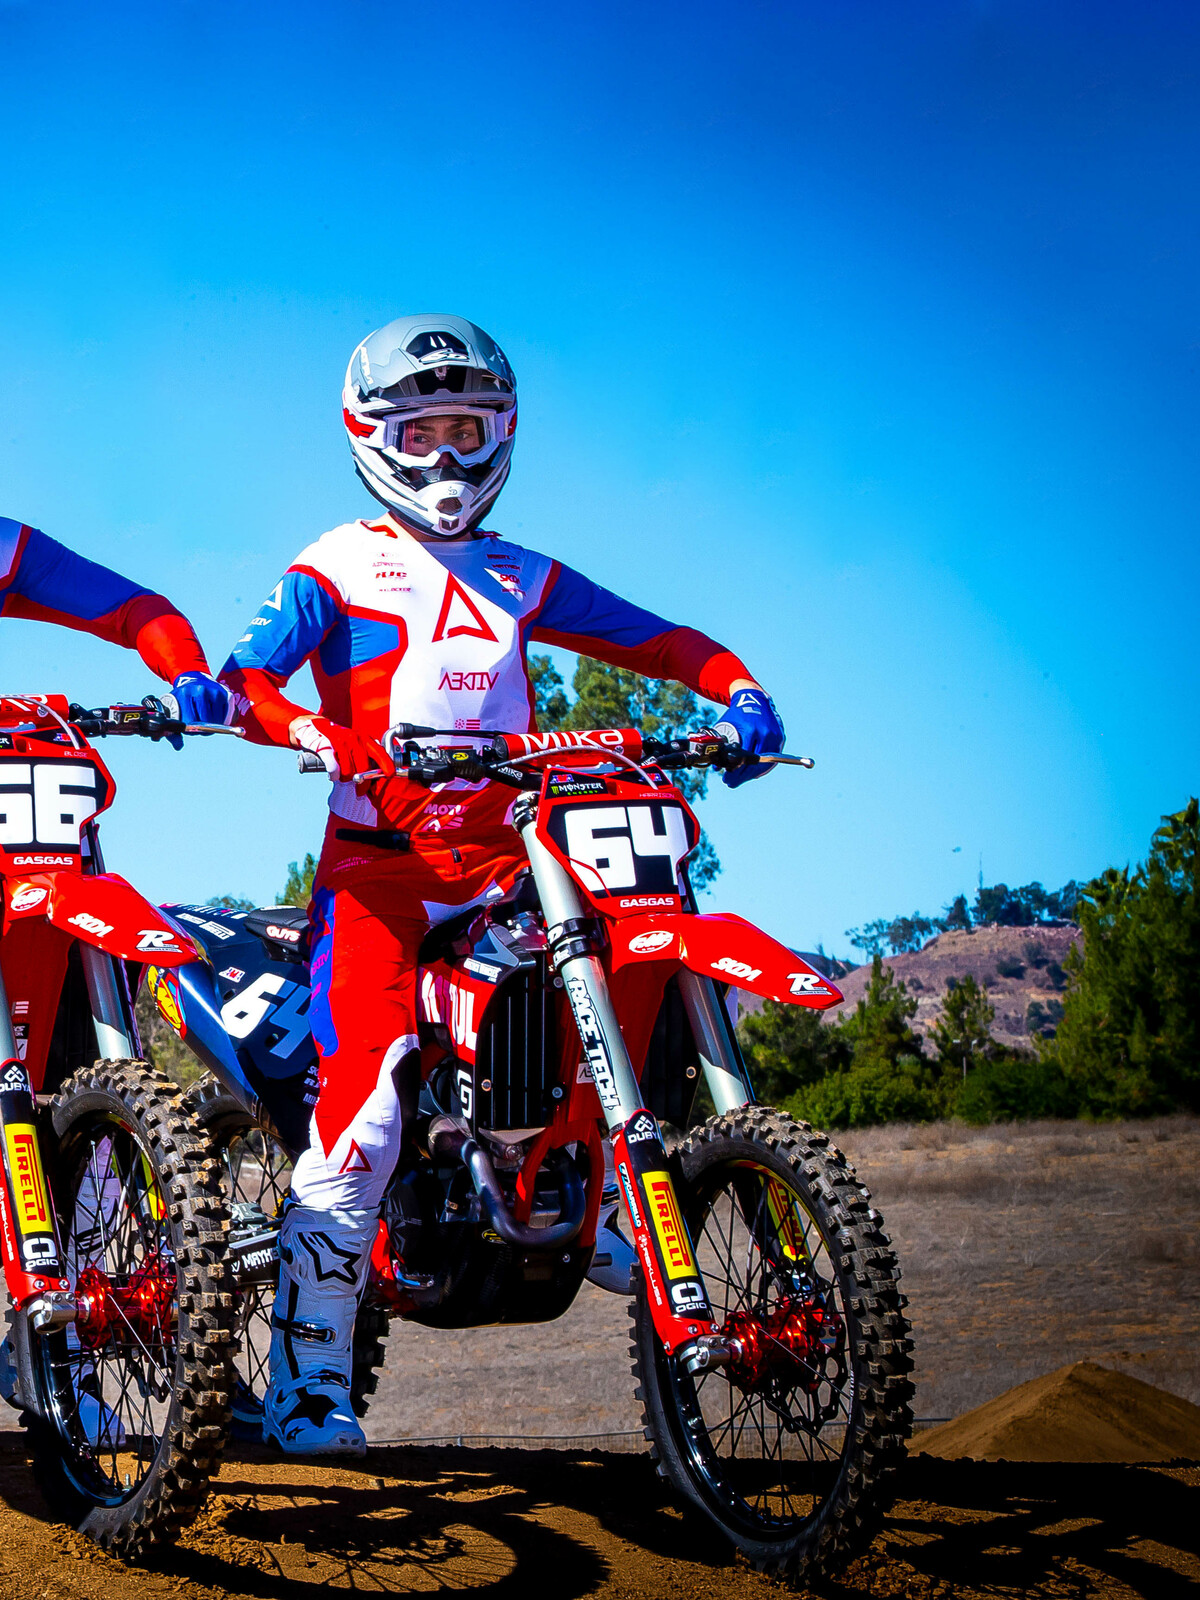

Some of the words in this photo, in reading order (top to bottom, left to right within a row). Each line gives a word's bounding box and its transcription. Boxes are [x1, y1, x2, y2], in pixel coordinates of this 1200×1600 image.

[558, 782, 604, 791] MONSTER
[564, 806, 689, 893] 64
[13, 856, 73, 865] GASGAS
[620, 897, 674, 908] GASGAS
[265, 925, 301, 942] GUTS
[567, 979, 601, 1040] RACE
[589, 1041, 621, 1108] TECH
[13, 1134, 47, 1222] PIRELLI
[651, 1181, 691, 1267] PIRELLI
[25, 1259, 59, 1269] OGIO
[675, 1303, 708, 1313] OGIO
